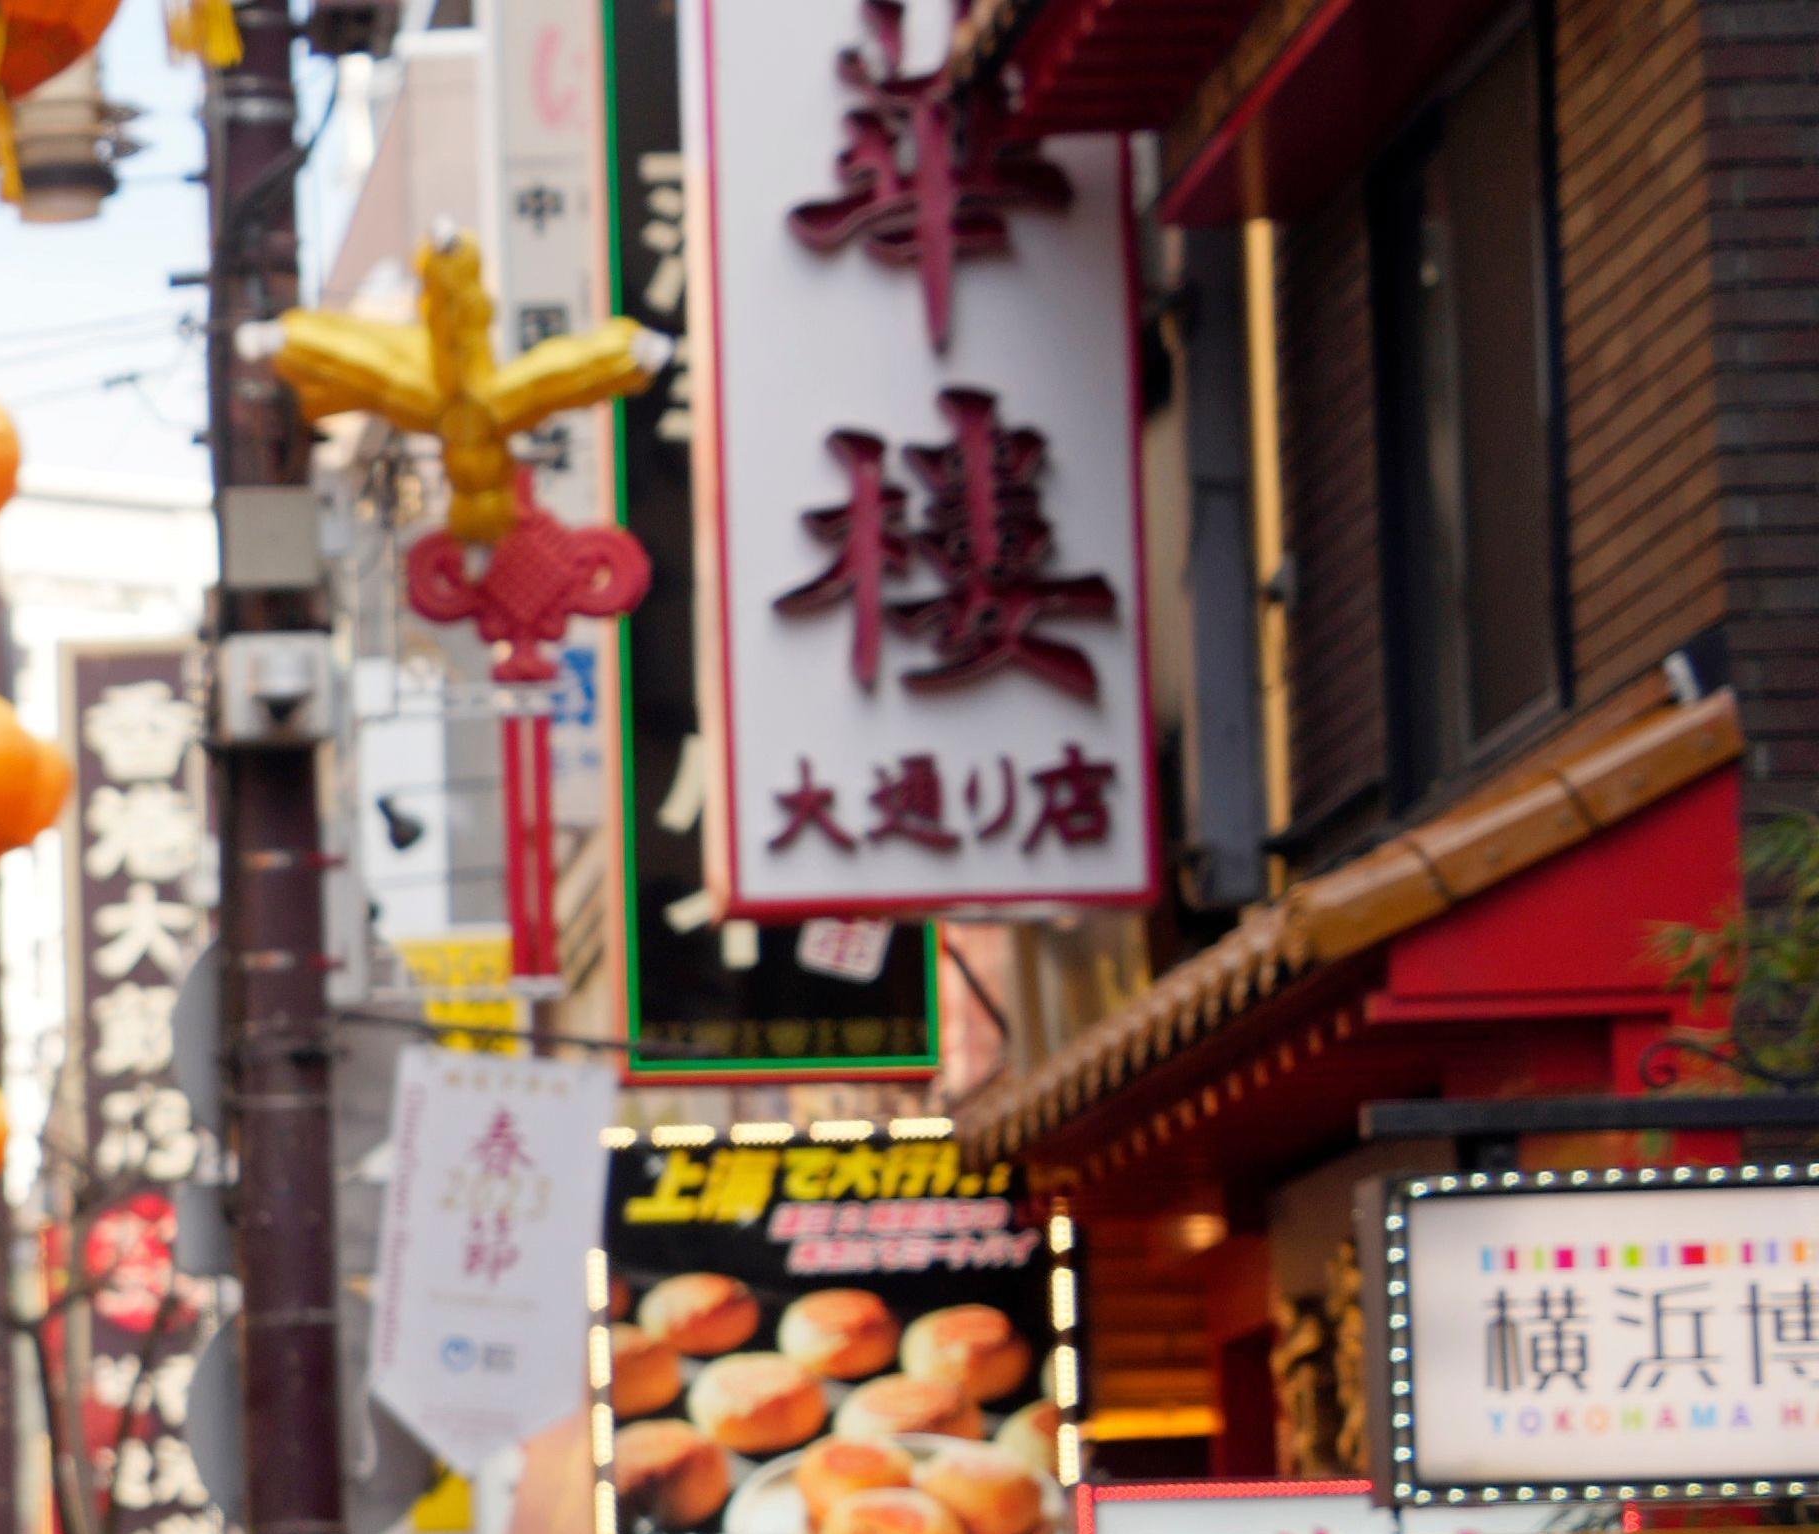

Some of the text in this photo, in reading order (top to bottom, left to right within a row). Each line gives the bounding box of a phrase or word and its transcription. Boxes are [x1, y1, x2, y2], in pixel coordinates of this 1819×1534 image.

[768, 745, 1116, 855] 大通り店
[1487, 1402, 1819, 1438] YOKOHAMA H
